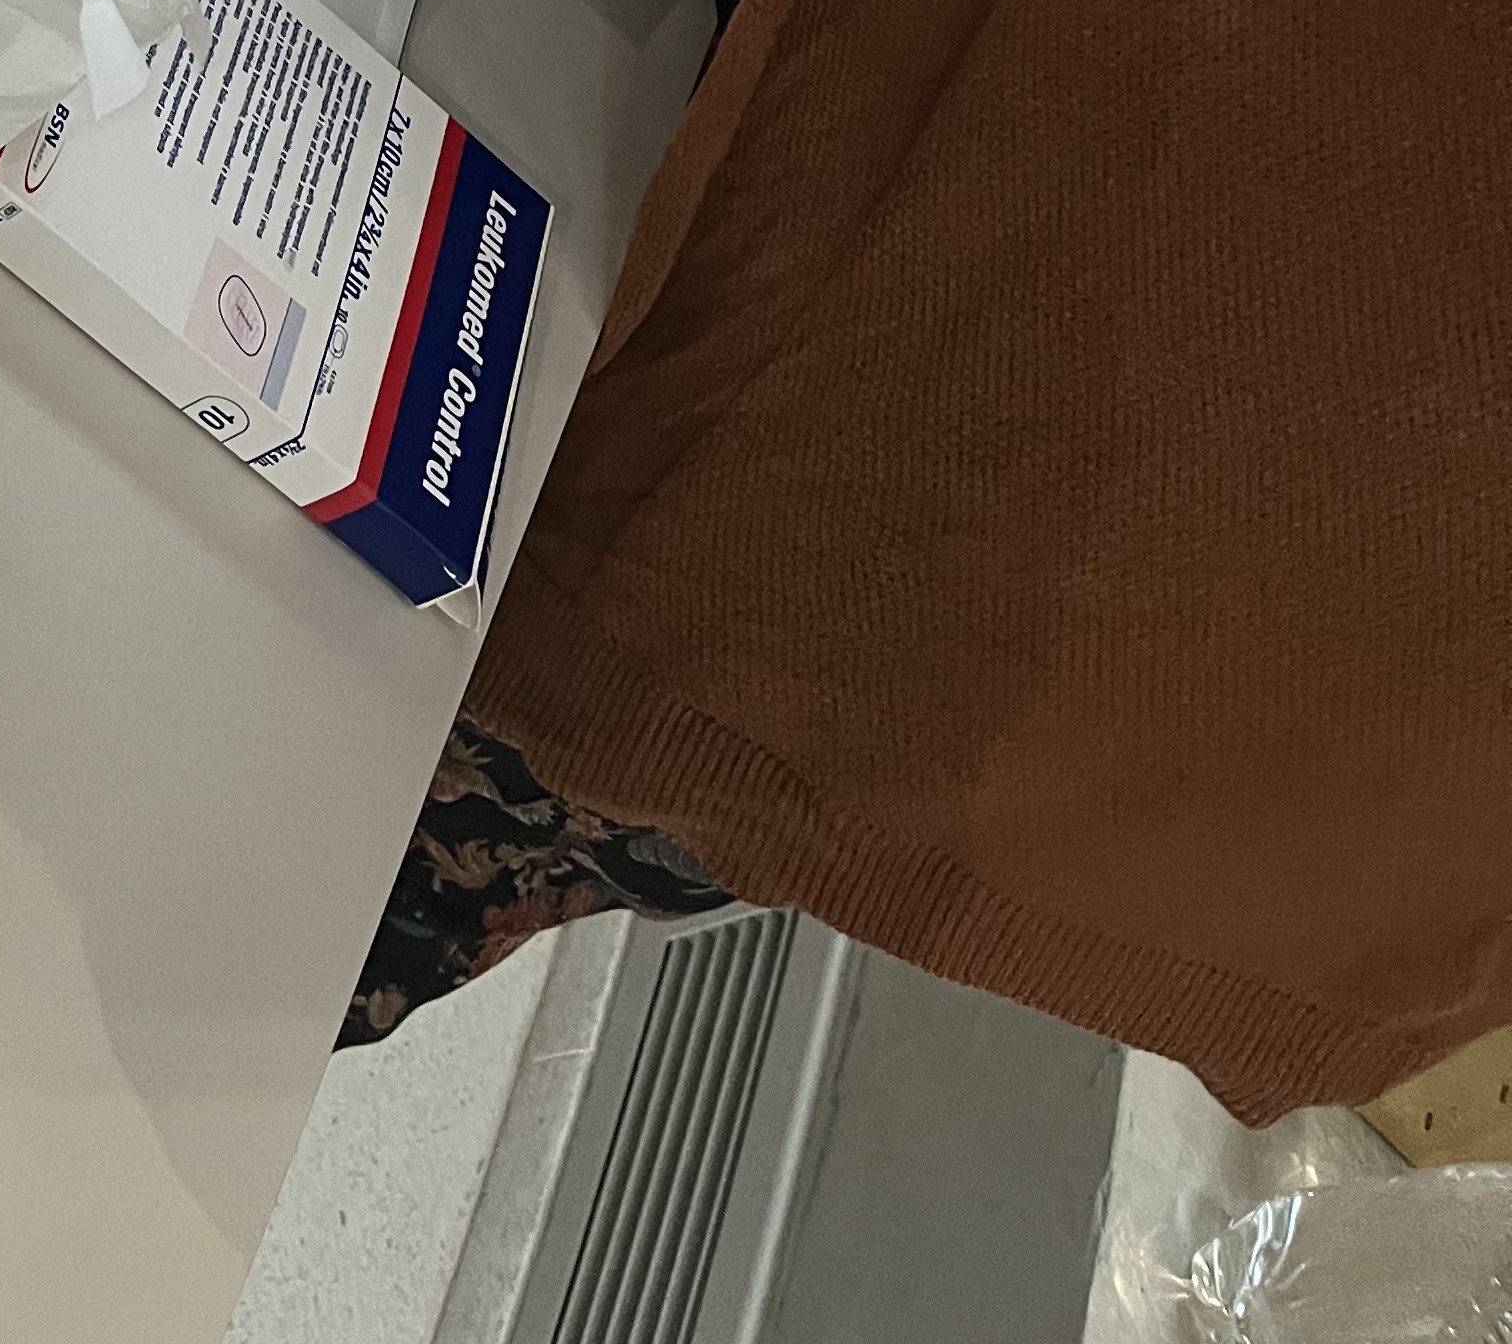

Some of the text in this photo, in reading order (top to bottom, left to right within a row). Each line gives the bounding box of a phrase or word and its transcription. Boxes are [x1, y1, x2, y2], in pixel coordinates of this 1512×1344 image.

[42, 102, 71, 148] BSN
[195, 404, 237, 432] 10
[420, 362, 478, 510] Control
